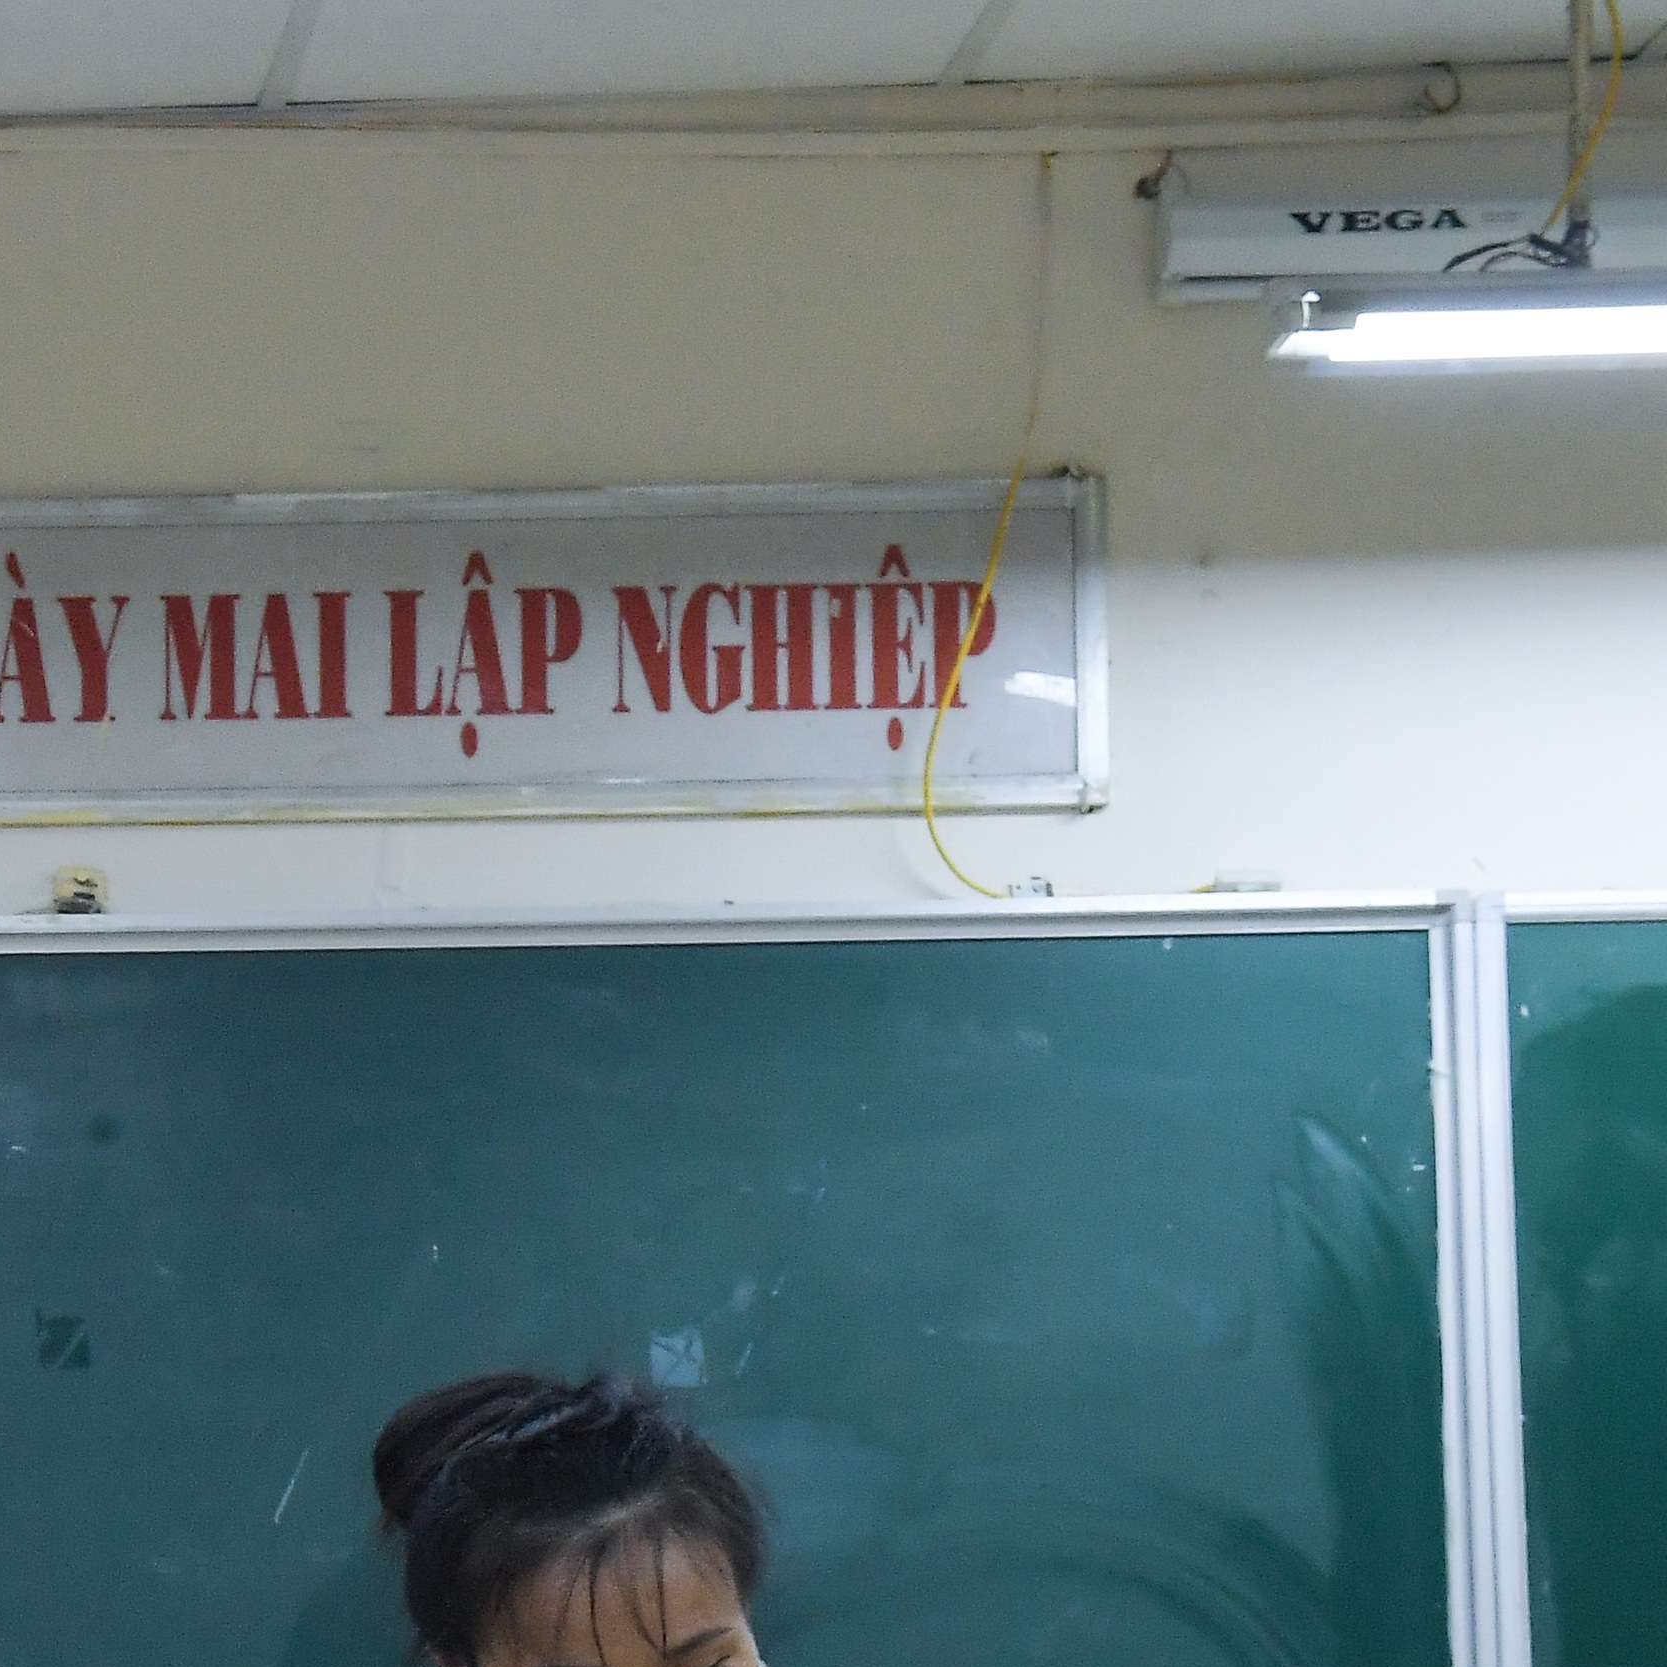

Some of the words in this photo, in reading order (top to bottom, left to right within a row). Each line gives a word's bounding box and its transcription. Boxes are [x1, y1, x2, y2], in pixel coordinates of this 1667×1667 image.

[1289, 208, 1468, 234] VEGA
[159, 593, 353, 722] MAI
[382, 552, 583, 760] LẬP
[613, 543, 997, 752] NGHIỆP
